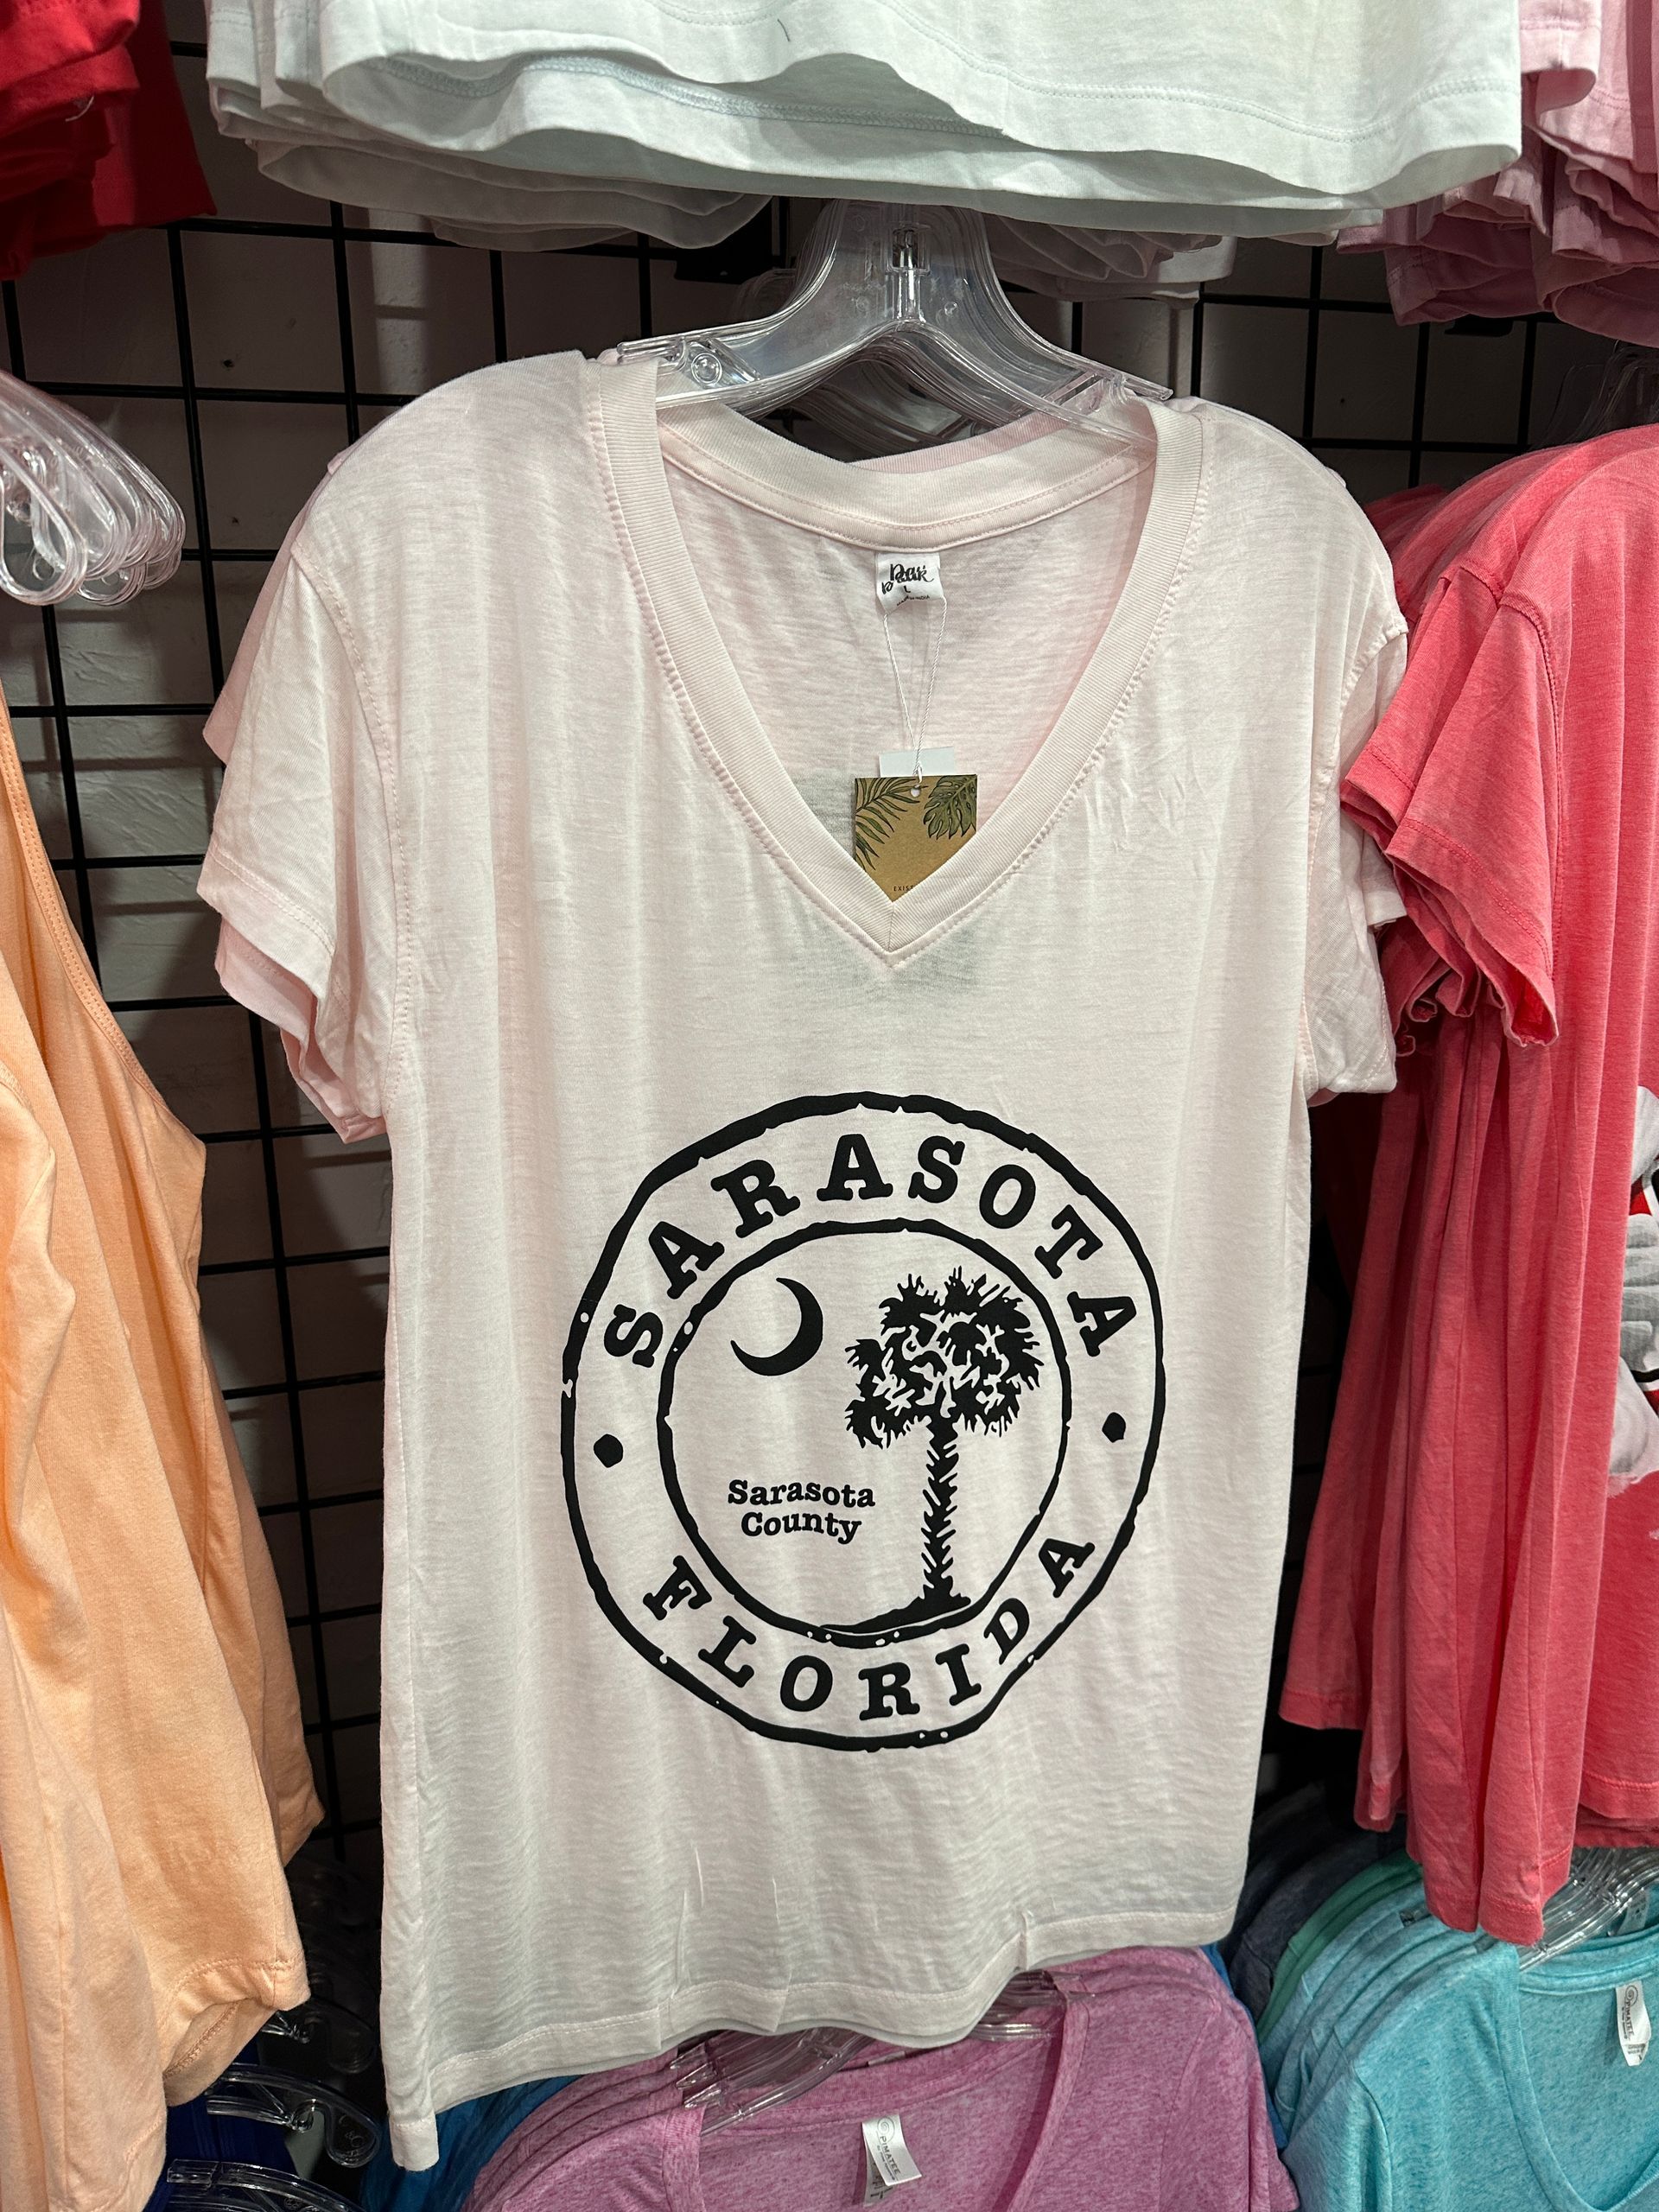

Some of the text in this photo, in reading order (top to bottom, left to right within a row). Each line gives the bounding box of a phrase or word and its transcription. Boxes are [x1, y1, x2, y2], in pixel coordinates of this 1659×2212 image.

[904, 585, 912, 594] L
[604, 1134, 1137, 1369] SARASOTA
[728, 1479, 876, 1509] Sarasota
[741, 1511, 862, 1545] County
[642, 1538, 1096, 1721] FLORIDA
[880, 2135, 900, 2175] PIMATEE
